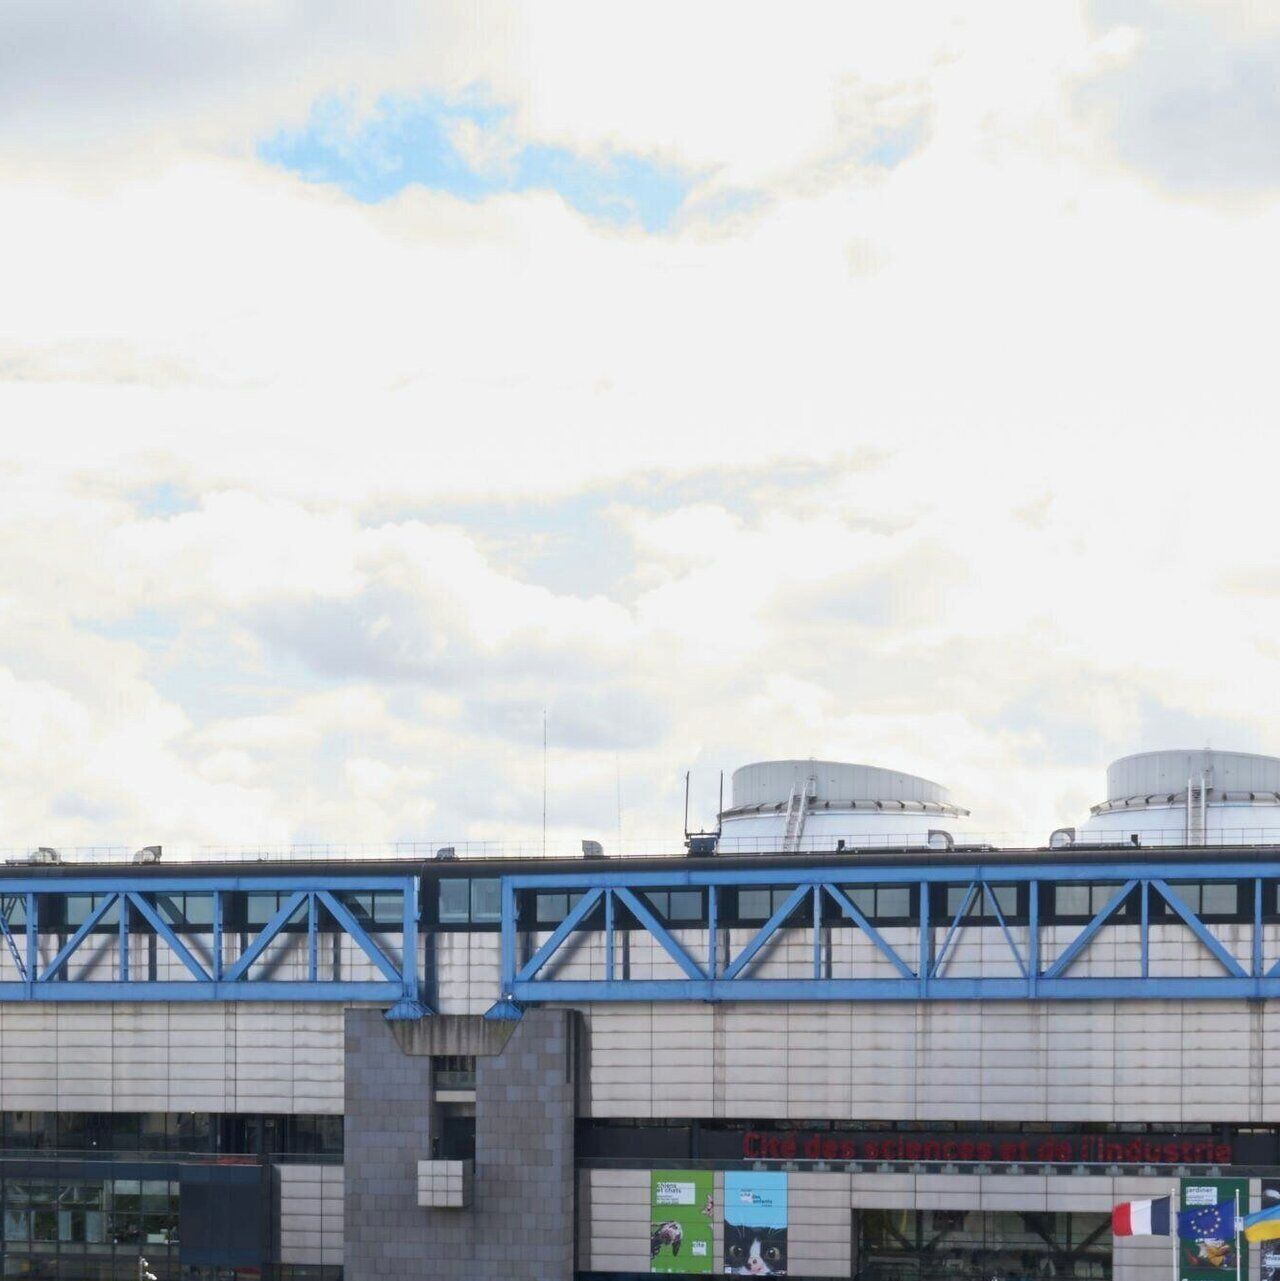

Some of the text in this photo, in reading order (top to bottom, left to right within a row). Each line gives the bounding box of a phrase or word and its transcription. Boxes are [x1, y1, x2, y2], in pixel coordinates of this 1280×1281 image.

[743, 1131, 1233, 1162] Cité des sciences et de l'industrie
